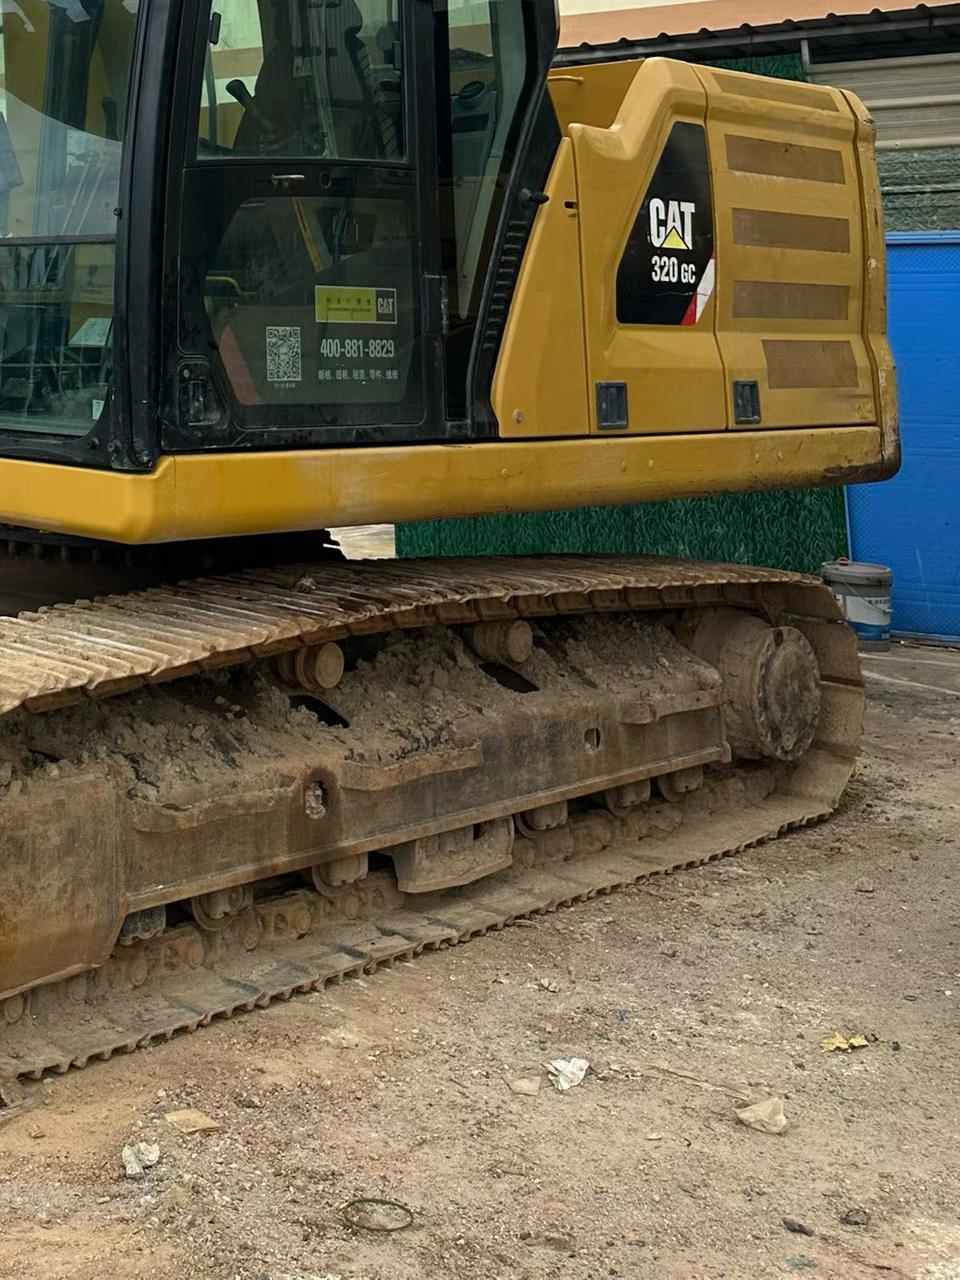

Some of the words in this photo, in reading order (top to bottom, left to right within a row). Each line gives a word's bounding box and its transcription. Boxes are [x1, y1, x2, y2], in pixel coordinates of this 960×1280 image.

[649, 198, 696, 250] CAT
[651, 255, 678, 283] 320
[680, 263, 696, 284] GC
[377, 297, 394, 314] CAT
[320, 338, 395, 358] 400-881-8829
